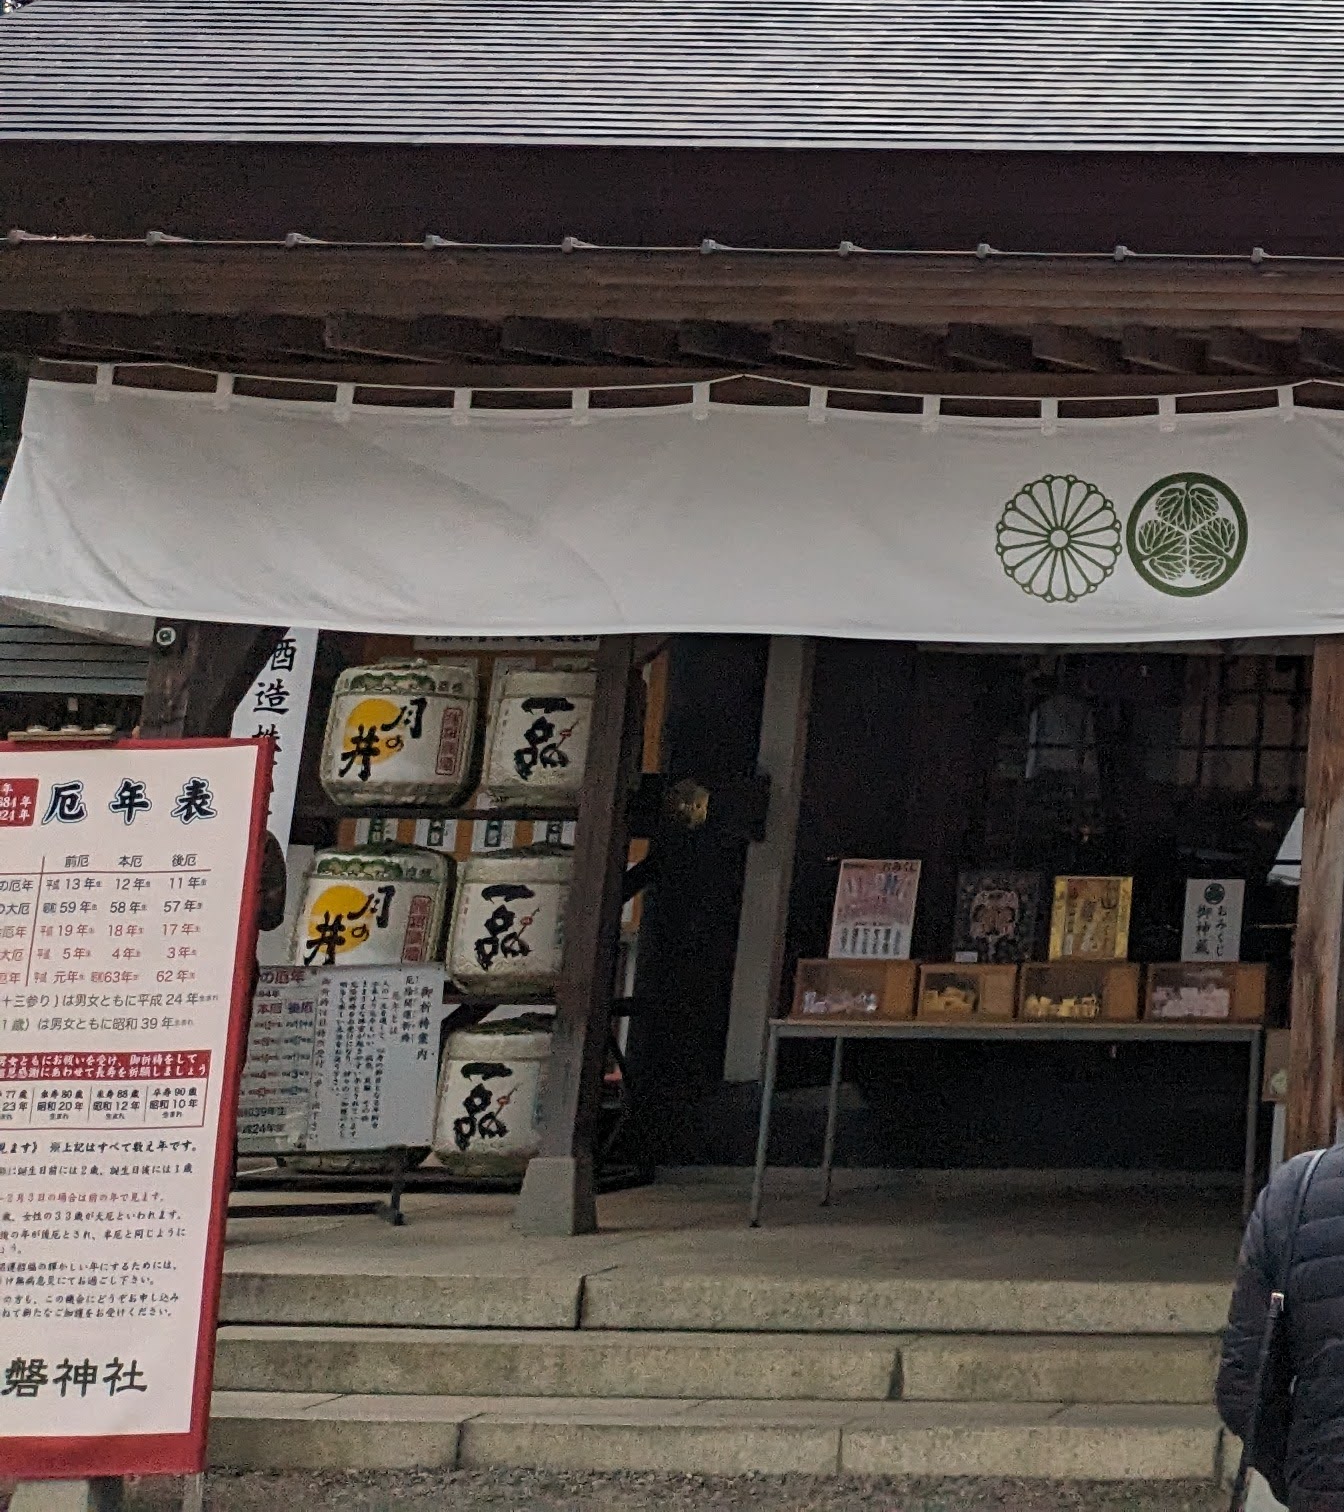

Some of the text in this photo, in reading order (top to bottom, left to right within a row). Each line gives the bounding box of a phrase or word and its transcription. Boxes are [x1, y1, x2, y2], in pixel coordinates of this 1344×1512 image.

[513, 696, 576, 781] 一品
[42, 778, 217, 825] 厄年表
[65, 854, 198, 867] 前厄 本厄 後厄
[474, 884, 536, 972] 一品
[453, 1061, 513, 1152] 一品
[1, 1356, 148, 1398] 磐神社
